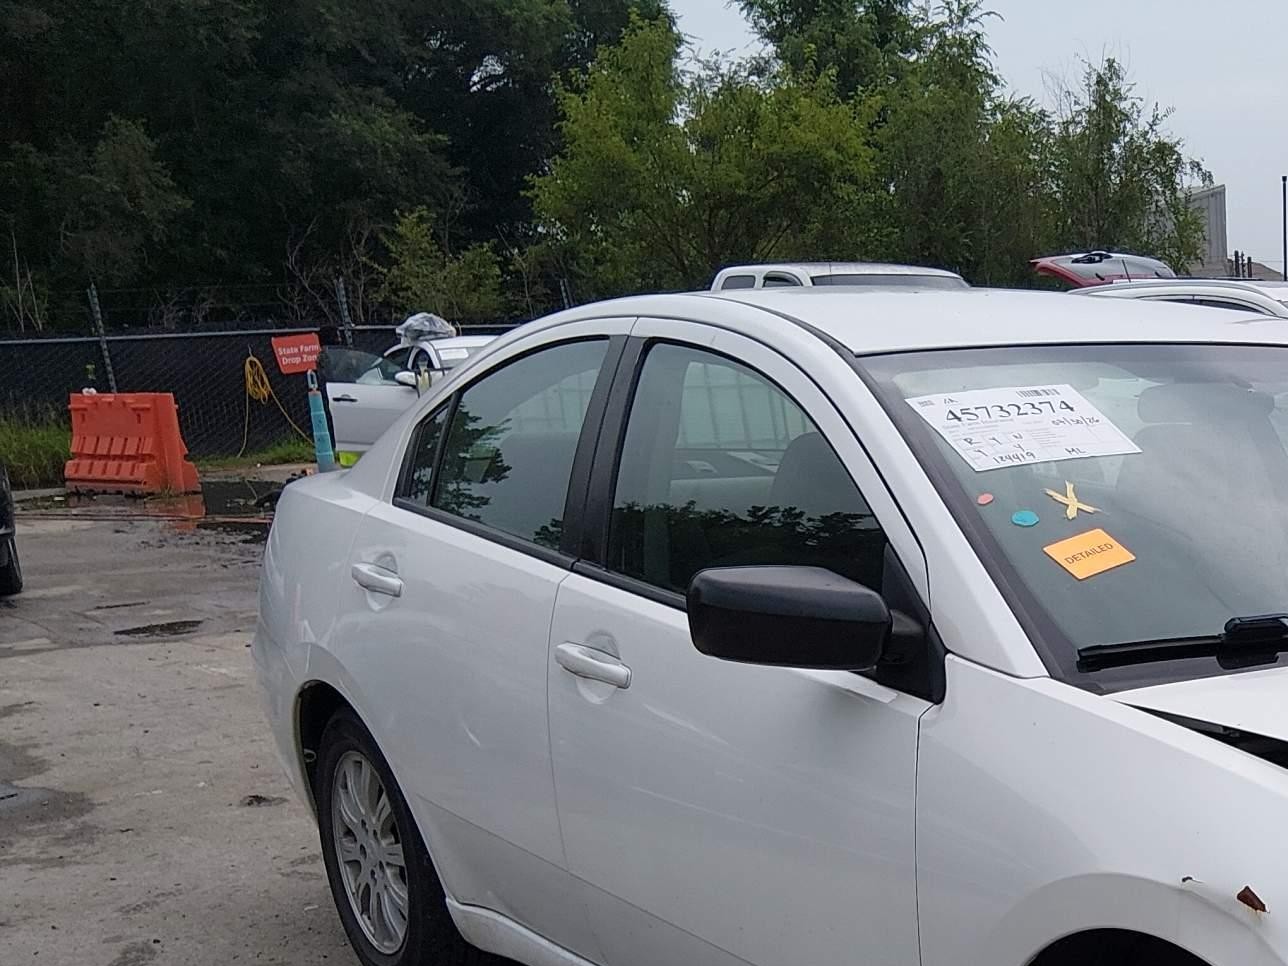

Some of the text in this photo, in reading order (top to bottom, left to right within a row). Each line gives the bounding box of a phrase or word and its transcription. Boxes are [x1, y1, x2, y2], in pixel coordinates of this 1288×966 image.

[277, 344, 319, 356] State Farm
[282, 354, 318, 365] Drop Zon
[946, 400, 1076, 422] 45732374
[1064, 542, 1114, 565] DETAILED
